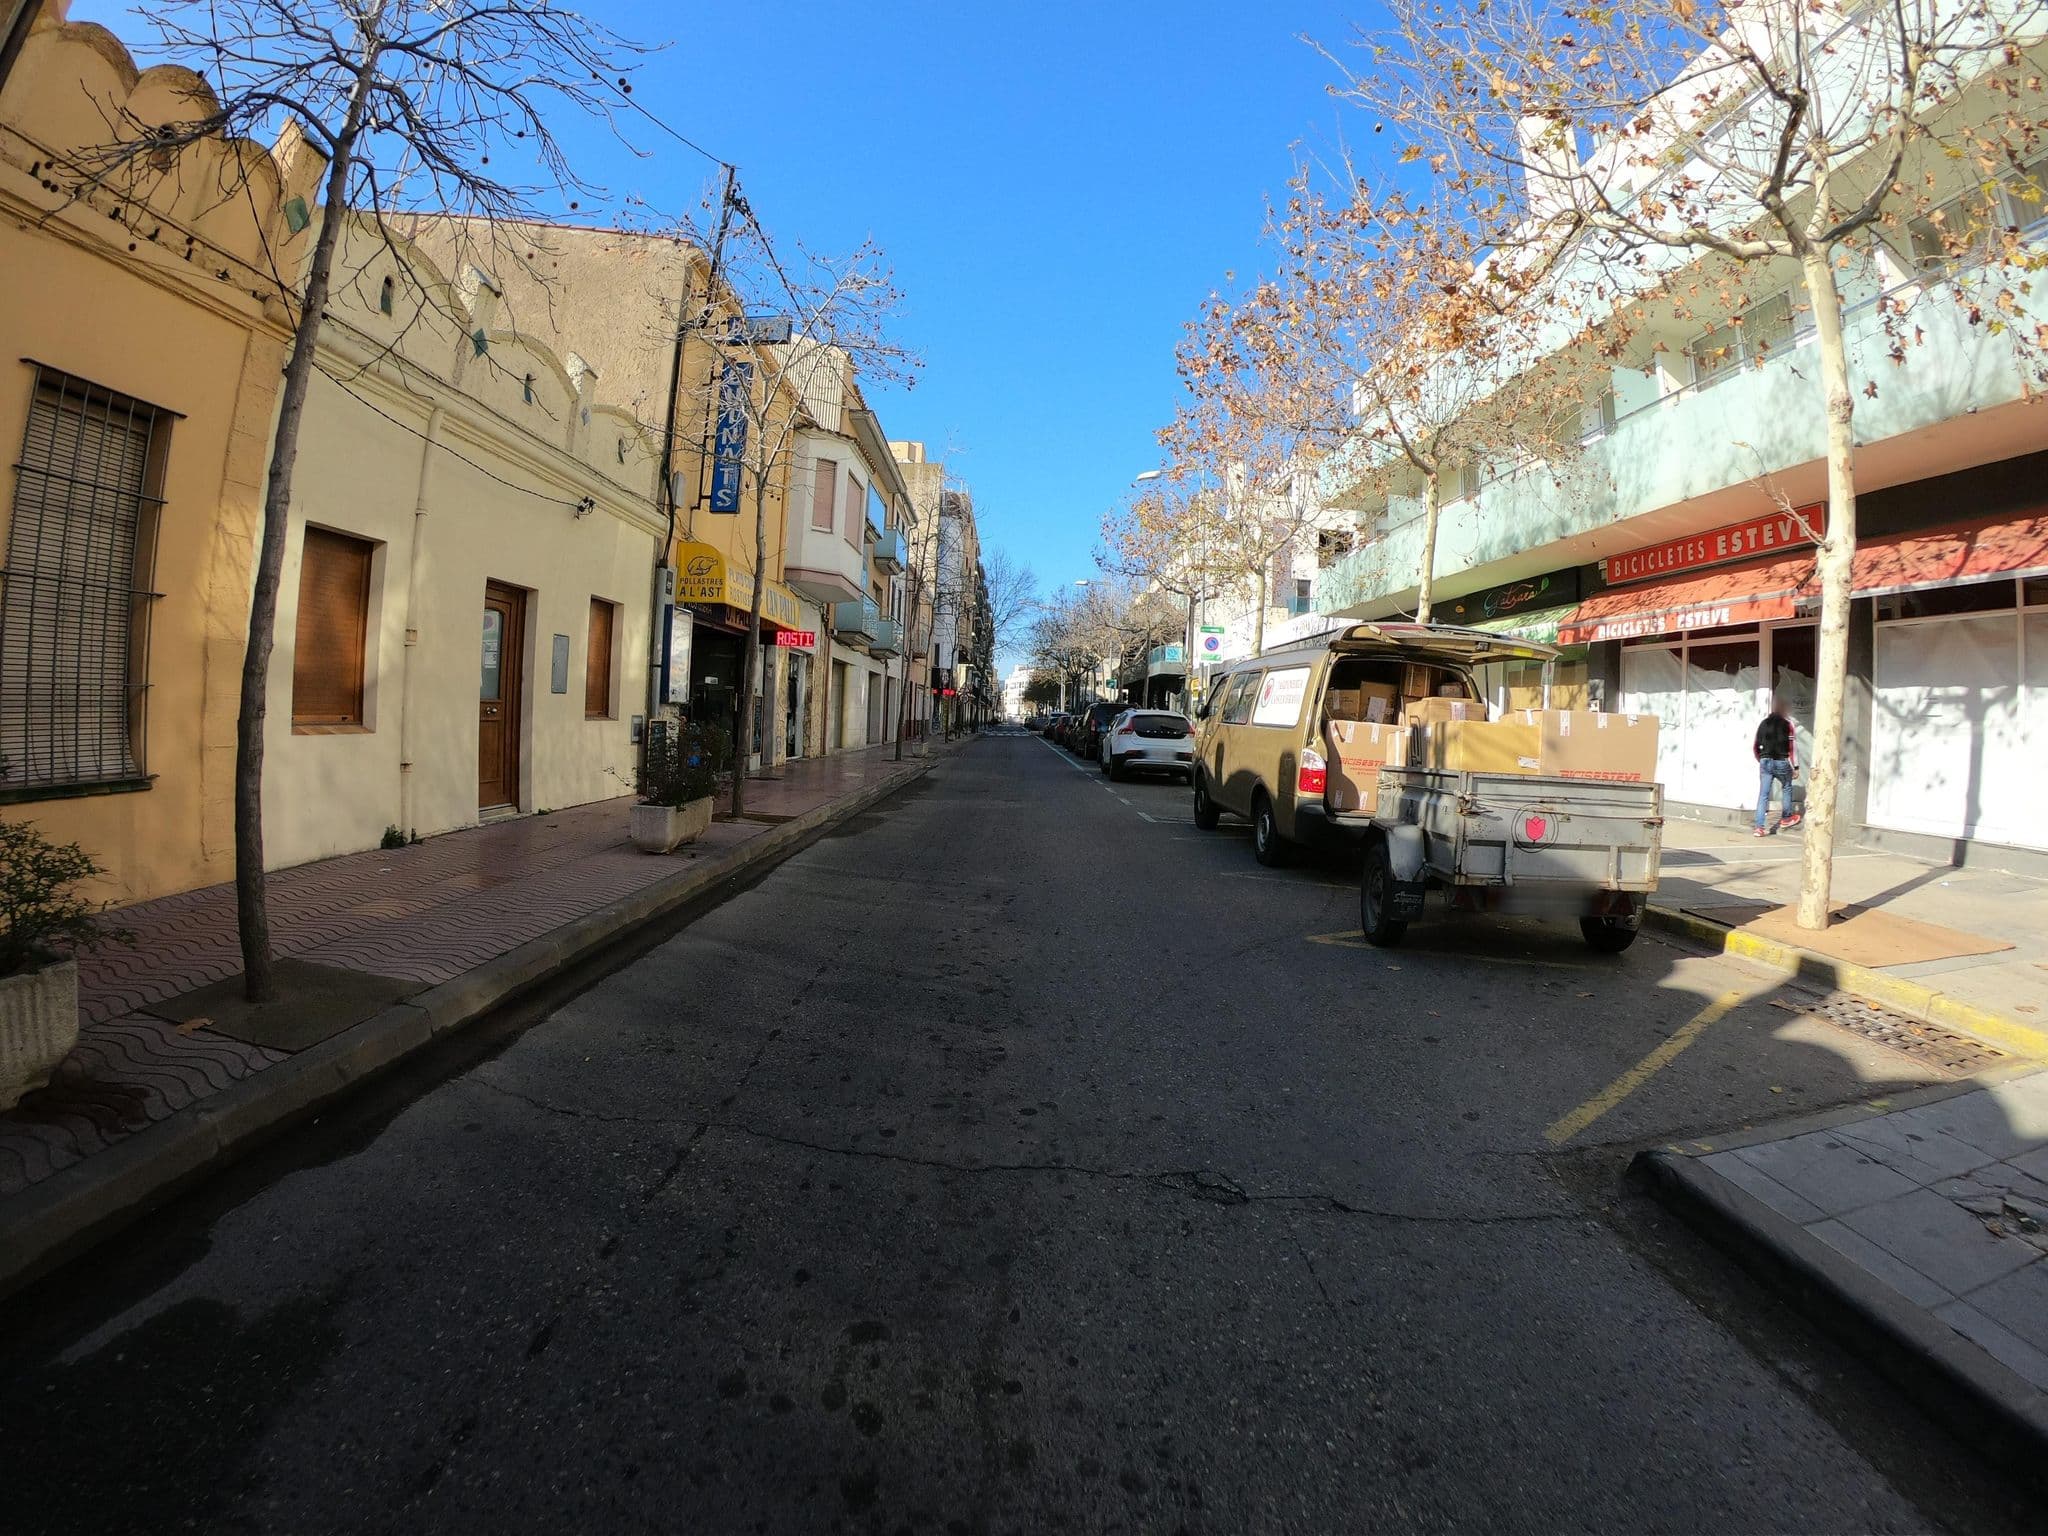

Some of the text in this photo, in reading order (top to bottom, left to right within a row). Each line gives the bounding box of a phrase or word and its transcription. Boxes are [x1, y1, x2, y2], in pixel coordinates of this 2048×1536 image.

[1615, 514, 1810, 577] BICICLETES ESTEVE
[679, 586, 687, 598] A
[680, 577, 723, 586] POLLASTRES
[1598, 608, 1730, 639] BICICLETES ESTEVE
